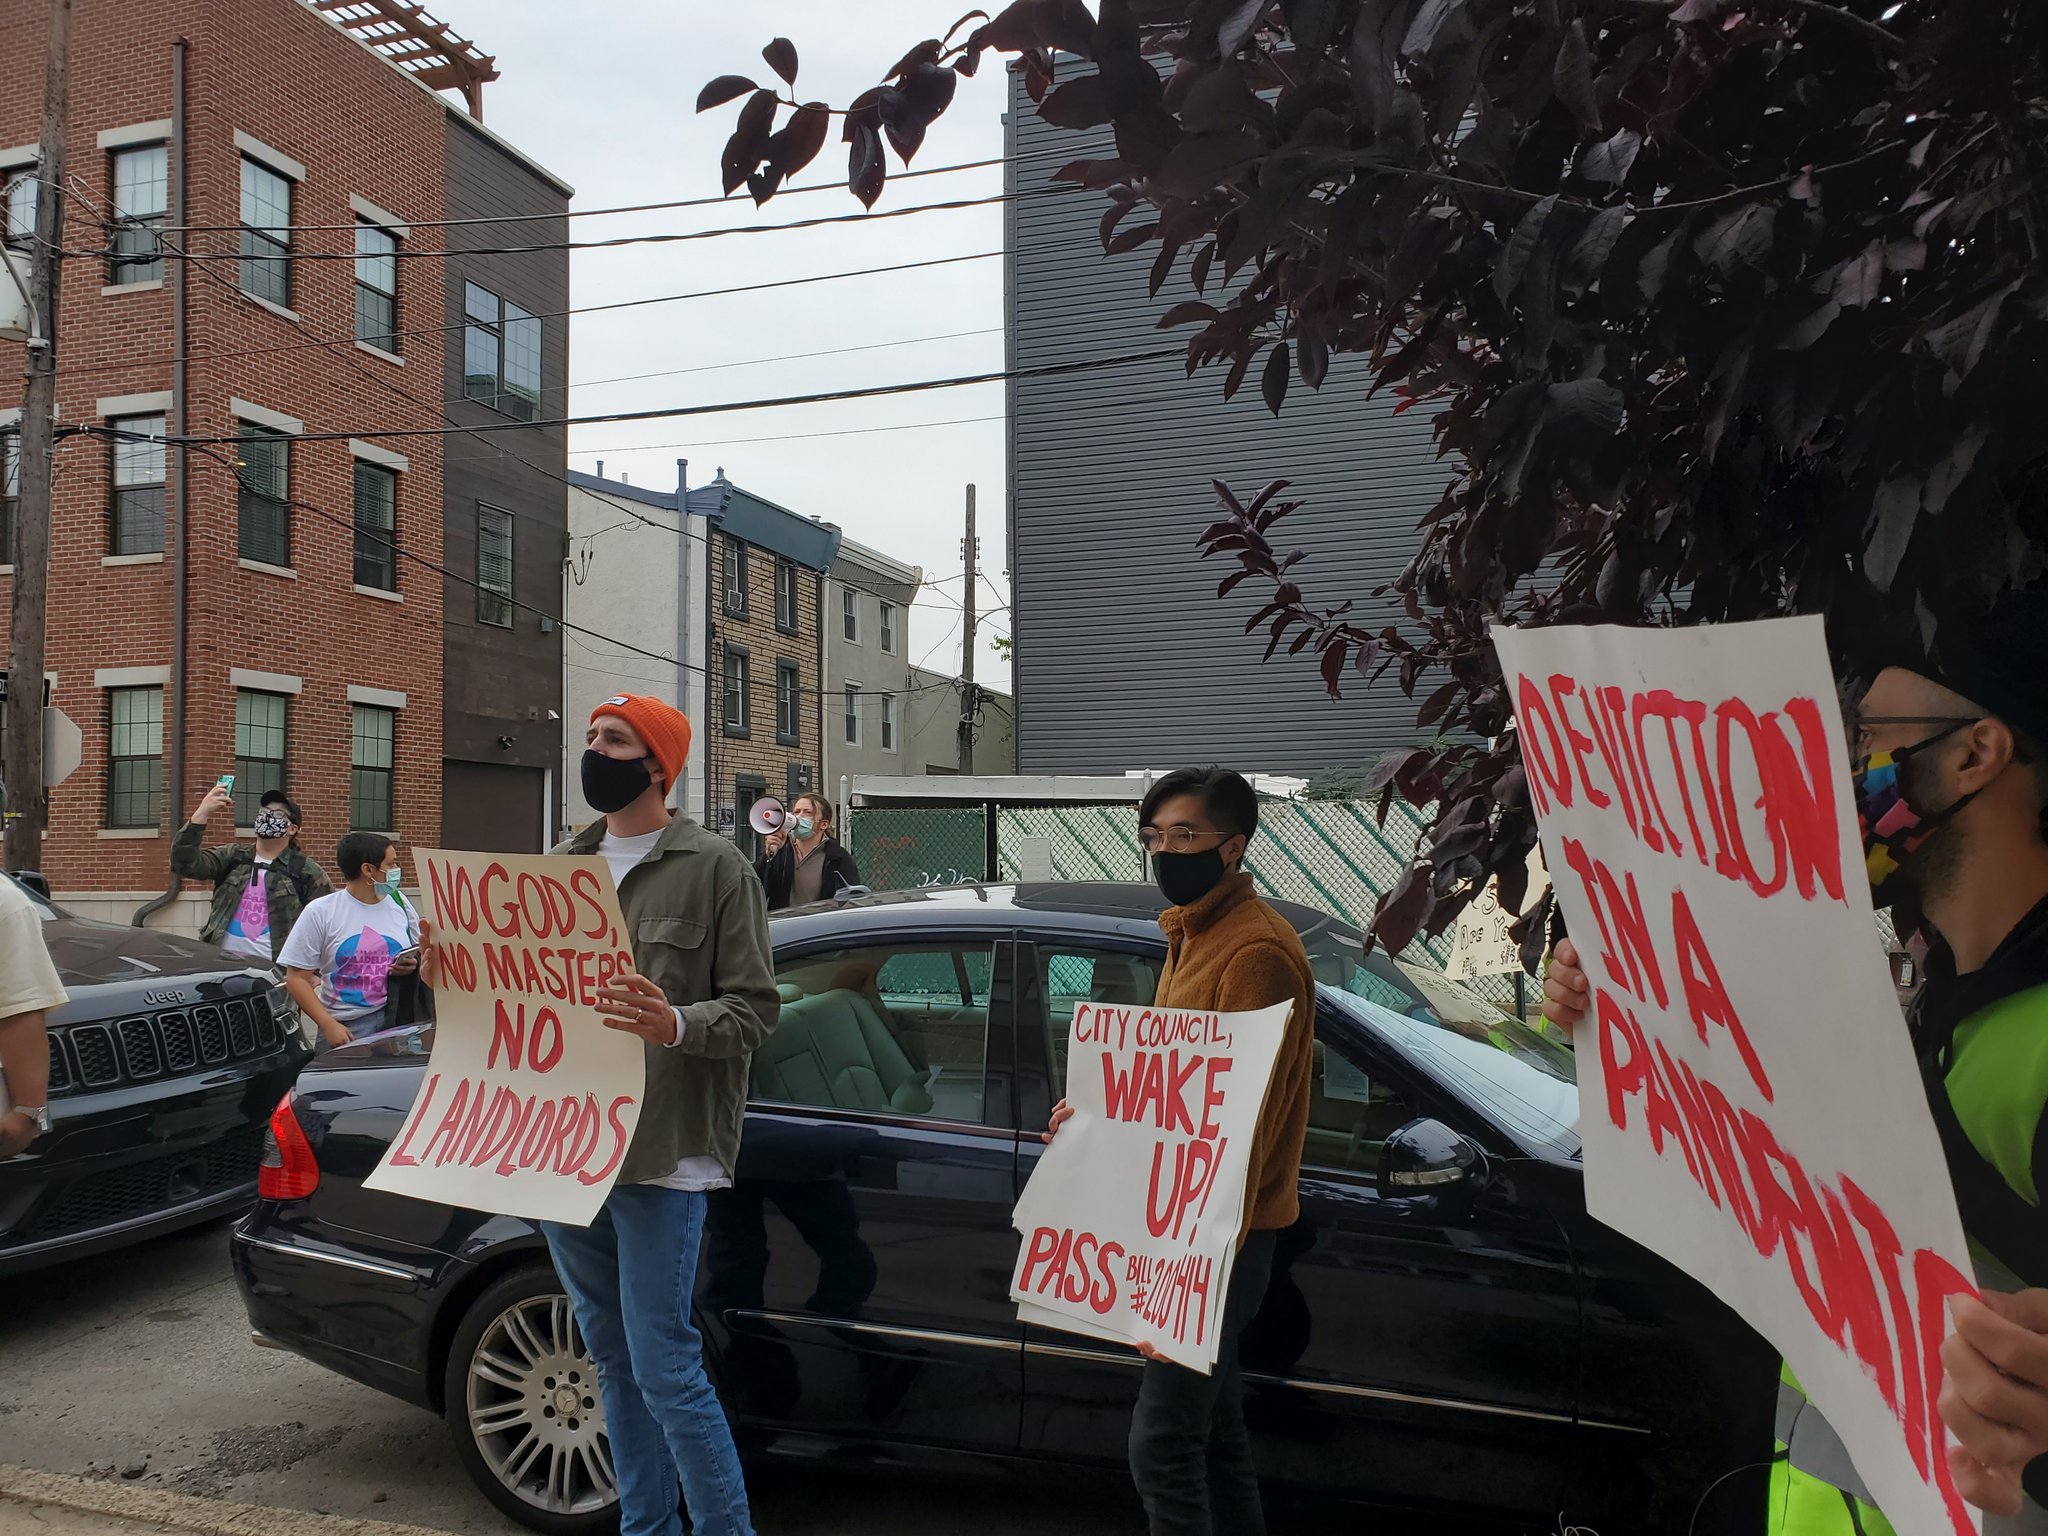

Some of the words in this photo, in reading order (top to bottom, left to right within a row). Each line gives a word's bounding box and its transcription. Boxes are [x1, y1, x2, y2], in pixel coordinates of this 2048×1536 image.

[1548, 674, 1849, 909] EVICTION
[427, 858, 478, 935] NO
[478, 862, 618, 948] GODS,
[143, 990, 186, 1005] Jeep
[438, 942, 477, 992] NO
[1562, 835, 1669, 1011] IN
[1671, 885, 1774, 1105] A
[487, 999, 564, 1073] NO
[1076, 1005, 1131, 1050] CITY
[1136, 1010, 1233, 1049] COUNCIL,
[389, 1073, 636, 1185] LANDLORDS
[1101, 1050, 1234, 1141] WAKE
[1146, 1137, 1228, 1247] UP!
[1019, 1227, 1125, 1314] PASS
[1126, 1255, 1152, 1285] BILL
